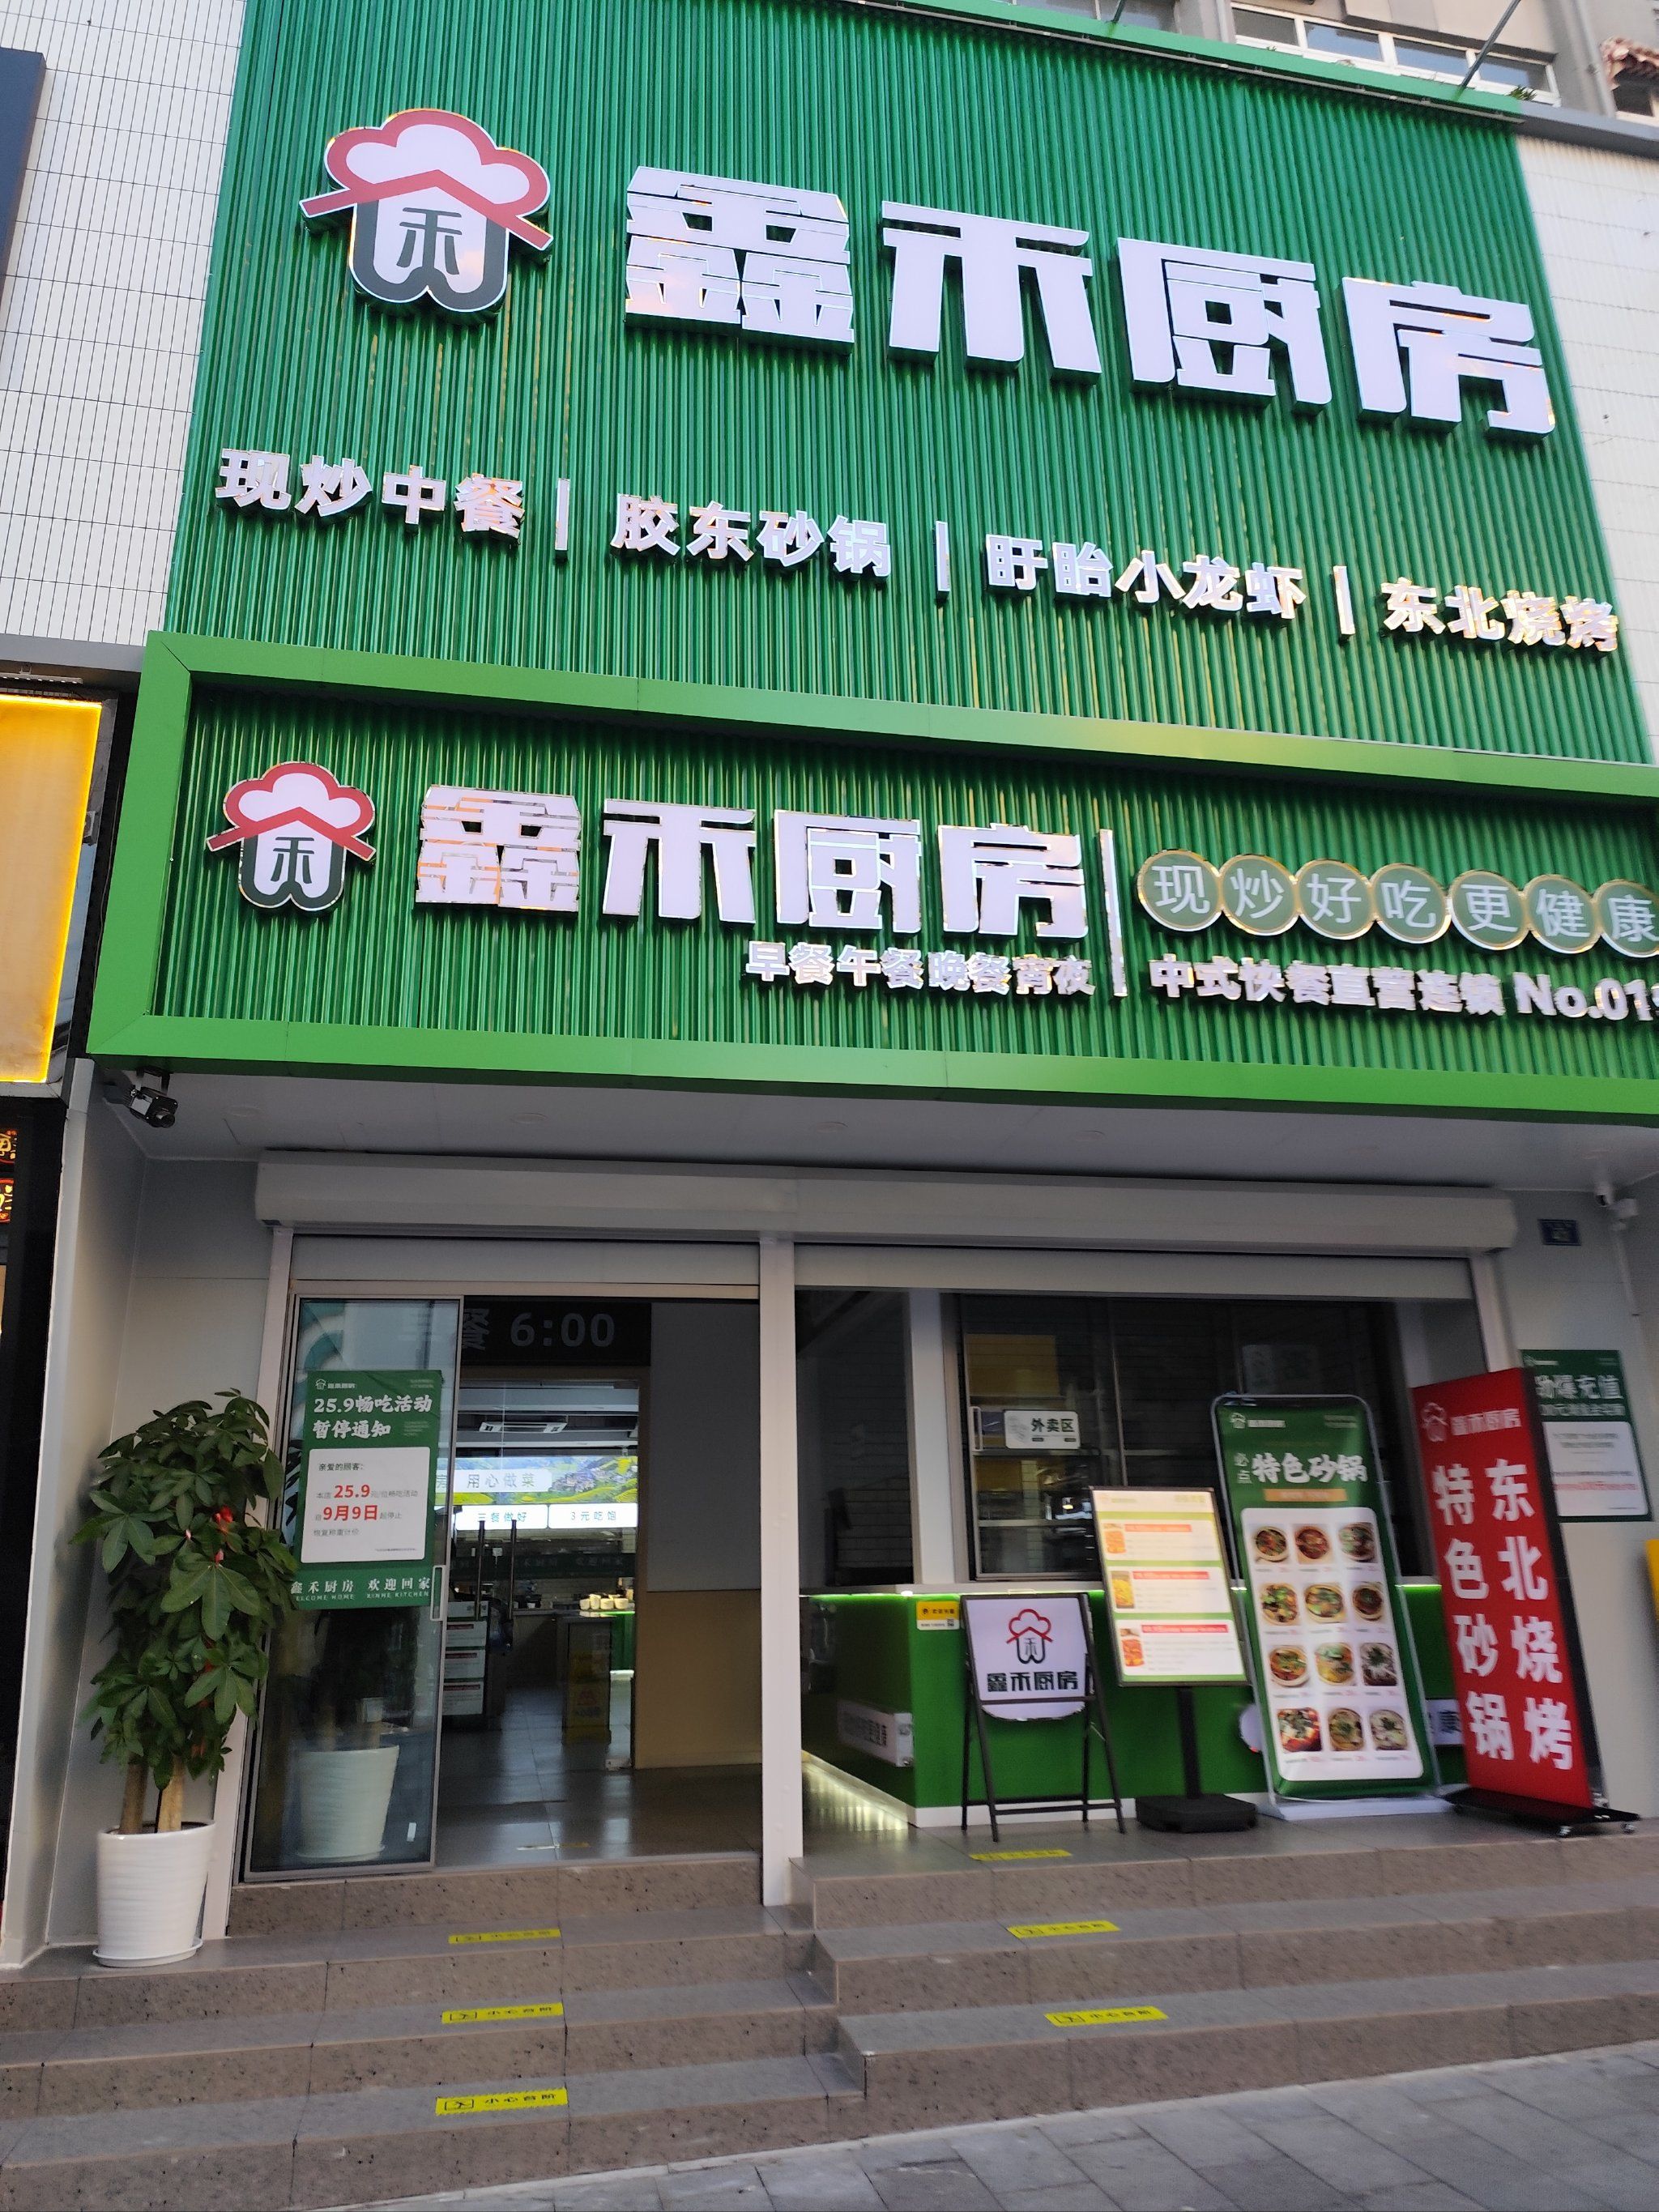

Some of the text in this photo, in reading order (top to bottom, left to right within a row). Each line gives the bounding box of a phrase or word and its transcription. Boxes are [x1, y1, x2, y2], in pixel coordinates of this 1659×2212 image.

[626, 166, 1555, 436] 鑫禾厨房
[215, 448, 1618, 652] 现炒中餐 胶东砂锅 盱眙小龙虾 东北烧烤
[416, 785, 1088, 939] 鑫禾厨房
[1150, 863, 1659, 943] 现炒好吃更健康
[745, 940, 1095, 995] 早餐午餐晚餐宵夜
[1149, 953, 1506, 1016] 中式快餐直营连锁
[510, 1312, 615, 1347] 6:00
[313, 1394, 433, 1413] 25.9畅吃活动
[1031, 1417, 1076, 1433] 外卖区
[313, 1419, 391, 1439] 暂停通知
[467, 1473, 535, 1489] 用心做菜
[1251, 1452, 1368, 1484] 特色砂锅
[290, 1577, 431, 1595] 鑫禾厨房 欢迎回家
[1431, 1463, 1515, 1761] 特色砂锅
[1485, 1458, 1574, 1771] 东北烧烤
[987, 1670, 1079, 1693] 鑫禾厨房
